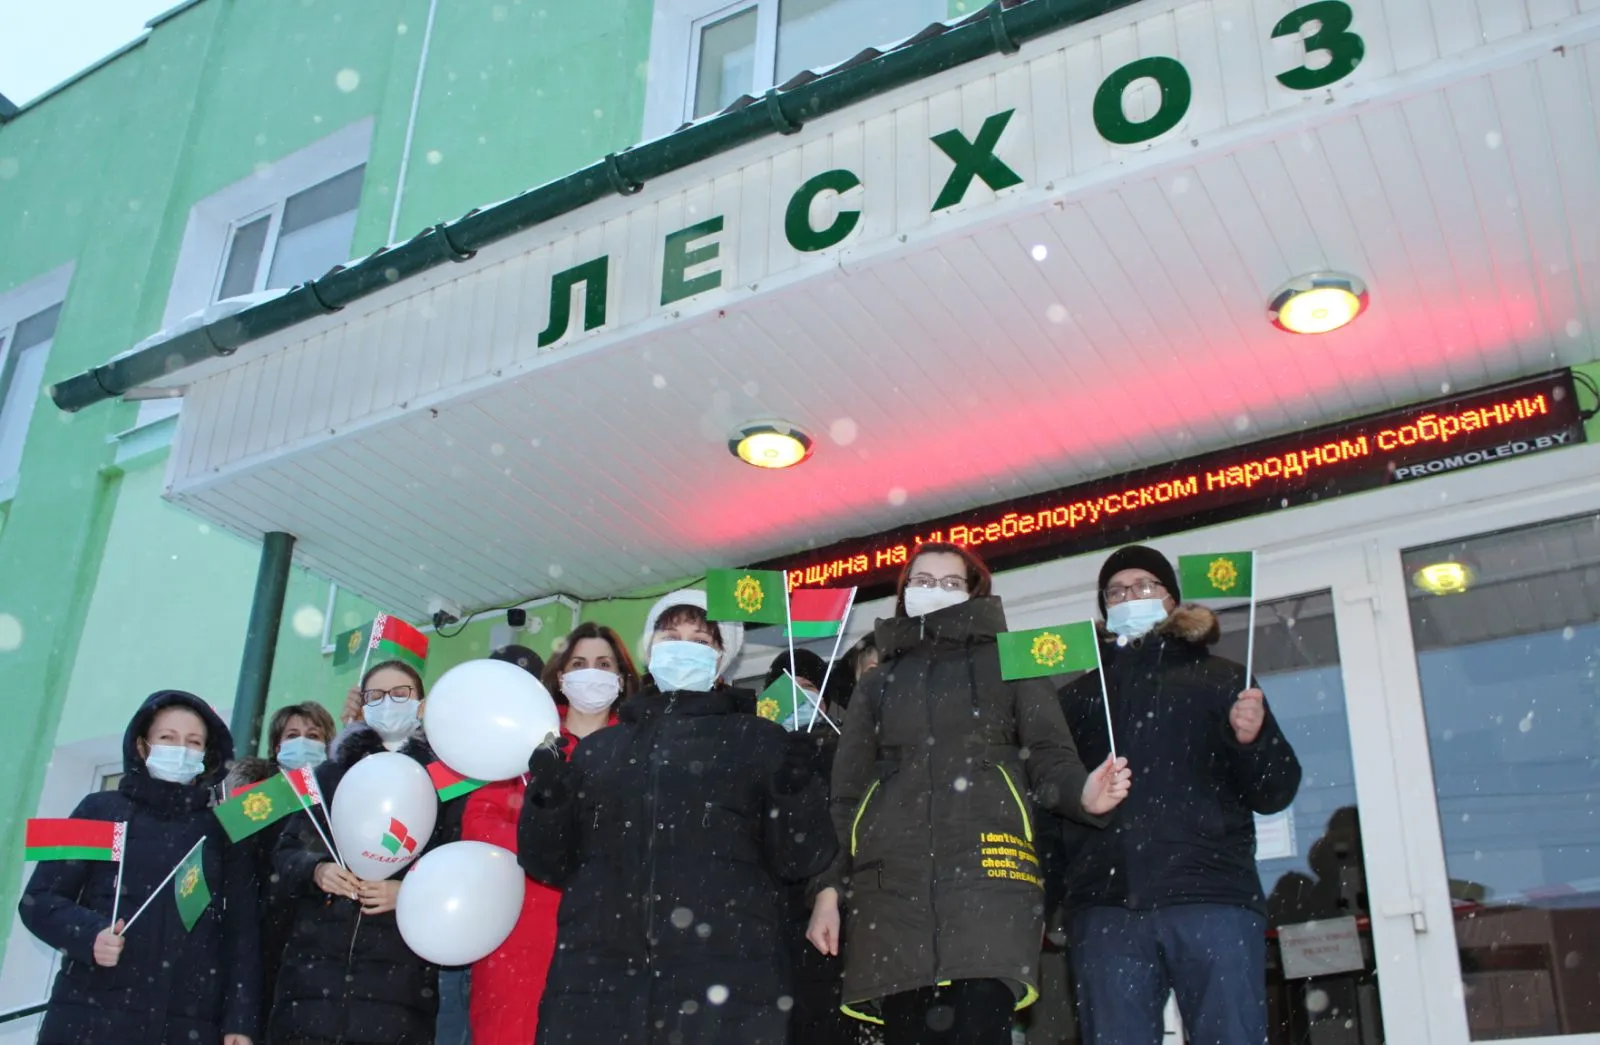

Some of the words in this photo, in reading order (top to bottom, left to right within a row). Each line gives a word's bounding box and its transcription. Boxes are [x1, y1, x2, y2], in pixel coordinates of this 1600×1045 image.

[538, 0, 1365, 347] ЛЕСХОЗ
[1394, 431, 1569, 481] PROMOLED.BY
[788, 555, 869, 593] рщина
[876, 545, 907, 568] на
[1206, 436, 1370, 491] народном
[1377, 394, 1549, 451] собрании
[981, 846, 1017, 857] random
[988, 869, 1007, 878] OUR
